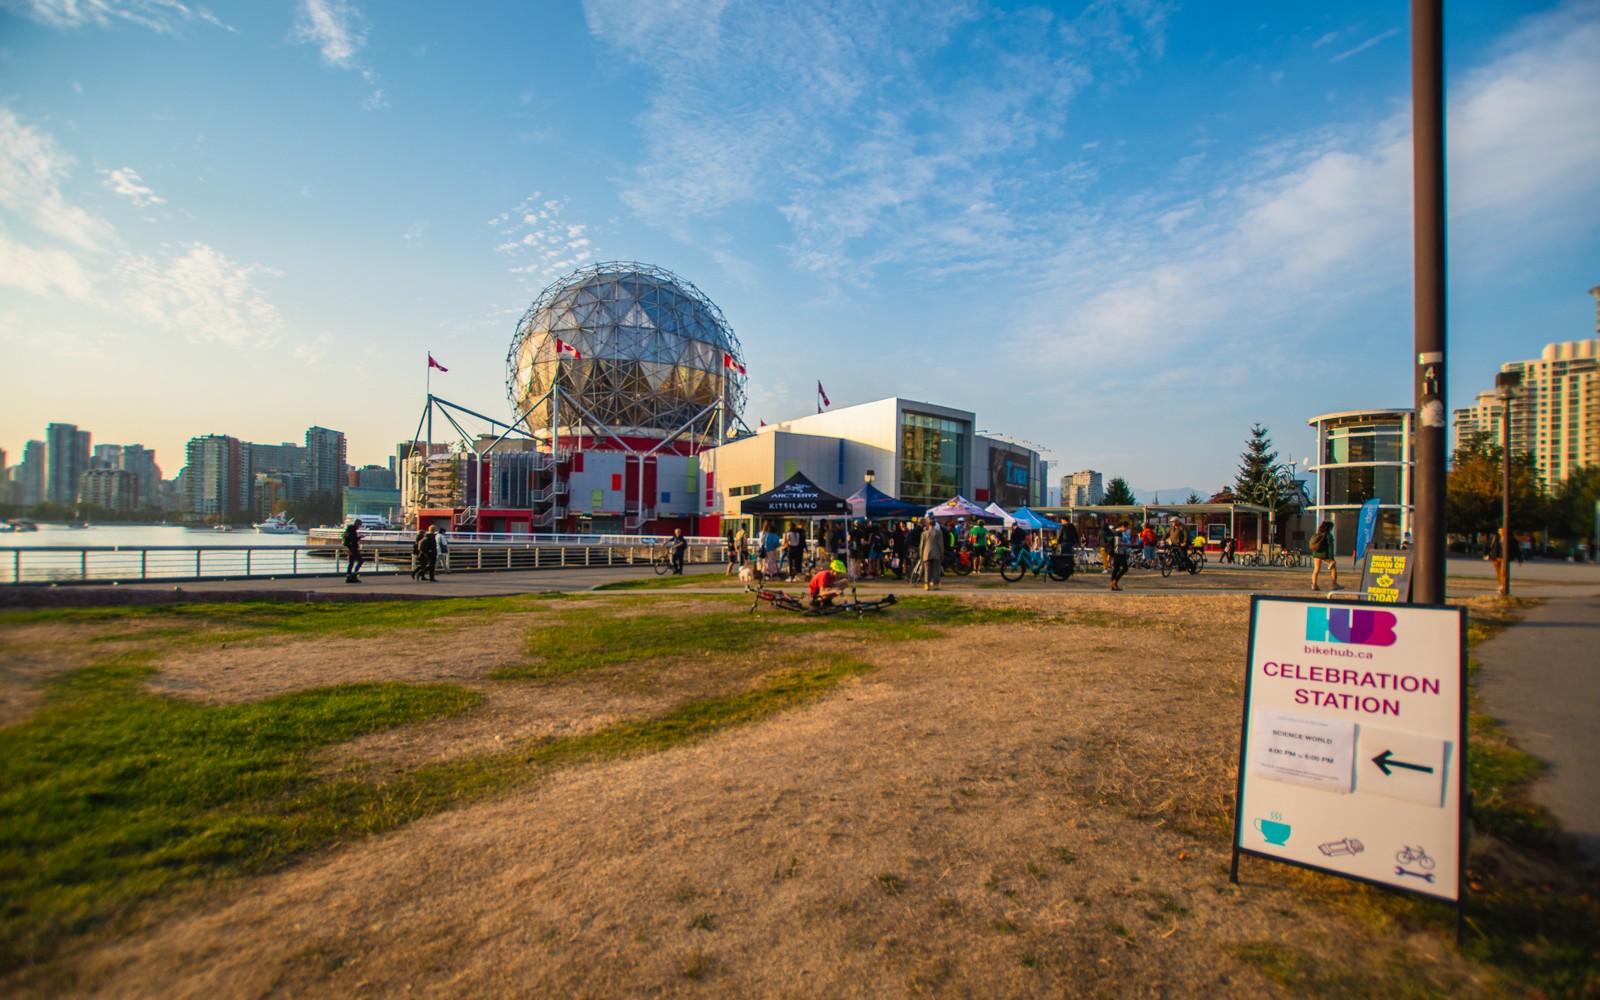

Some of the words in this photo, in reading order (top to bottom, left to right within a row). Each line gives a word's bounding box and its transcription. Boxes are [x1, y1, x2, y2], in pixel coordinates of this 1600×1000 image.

[769, 502, 817, 510] KITSILANO
[1306, 606, 1397, 647] HUB
[1304, 645, 1373, 660] bikehub.ca
[1263, 661, 1440, 695] CELEBRATION
[1294, 688, 1400, 716] STATION
[1272, 729, 1303, 739] SCIENCE
[1305, 734, 1333, 745] WORLD
[1322, 756, 1334, 764] PM
